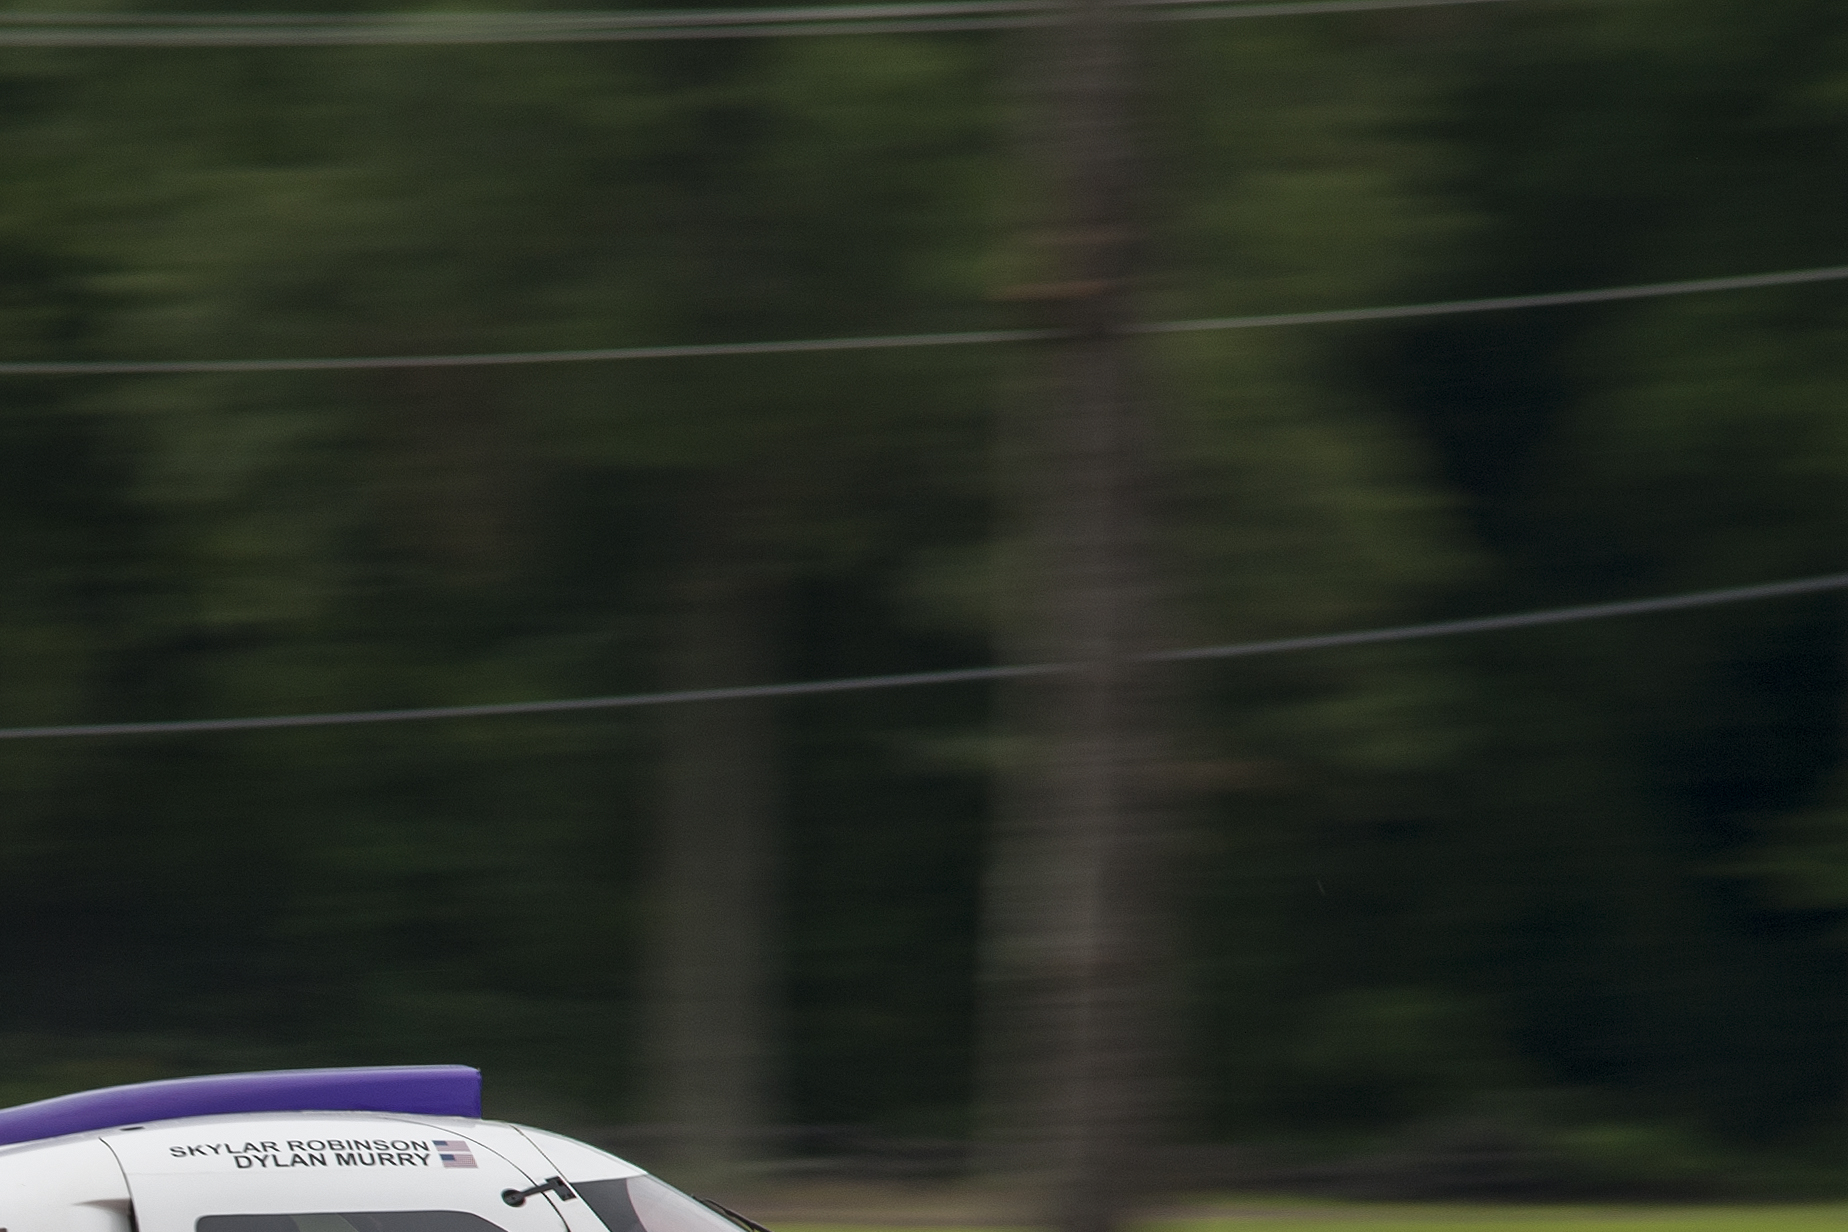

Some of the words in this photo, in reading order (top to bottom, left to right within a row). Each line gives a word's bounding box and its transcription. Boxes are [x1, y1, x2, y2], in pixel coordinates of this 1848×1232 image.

[169, 1139, 279, 1158] SKYLAR
[286, 1138, 431, 1152] ROBINSON
[234, 1152, 328, 1169] DYLAN
[336, 1152, 431, 1167] MURRY
